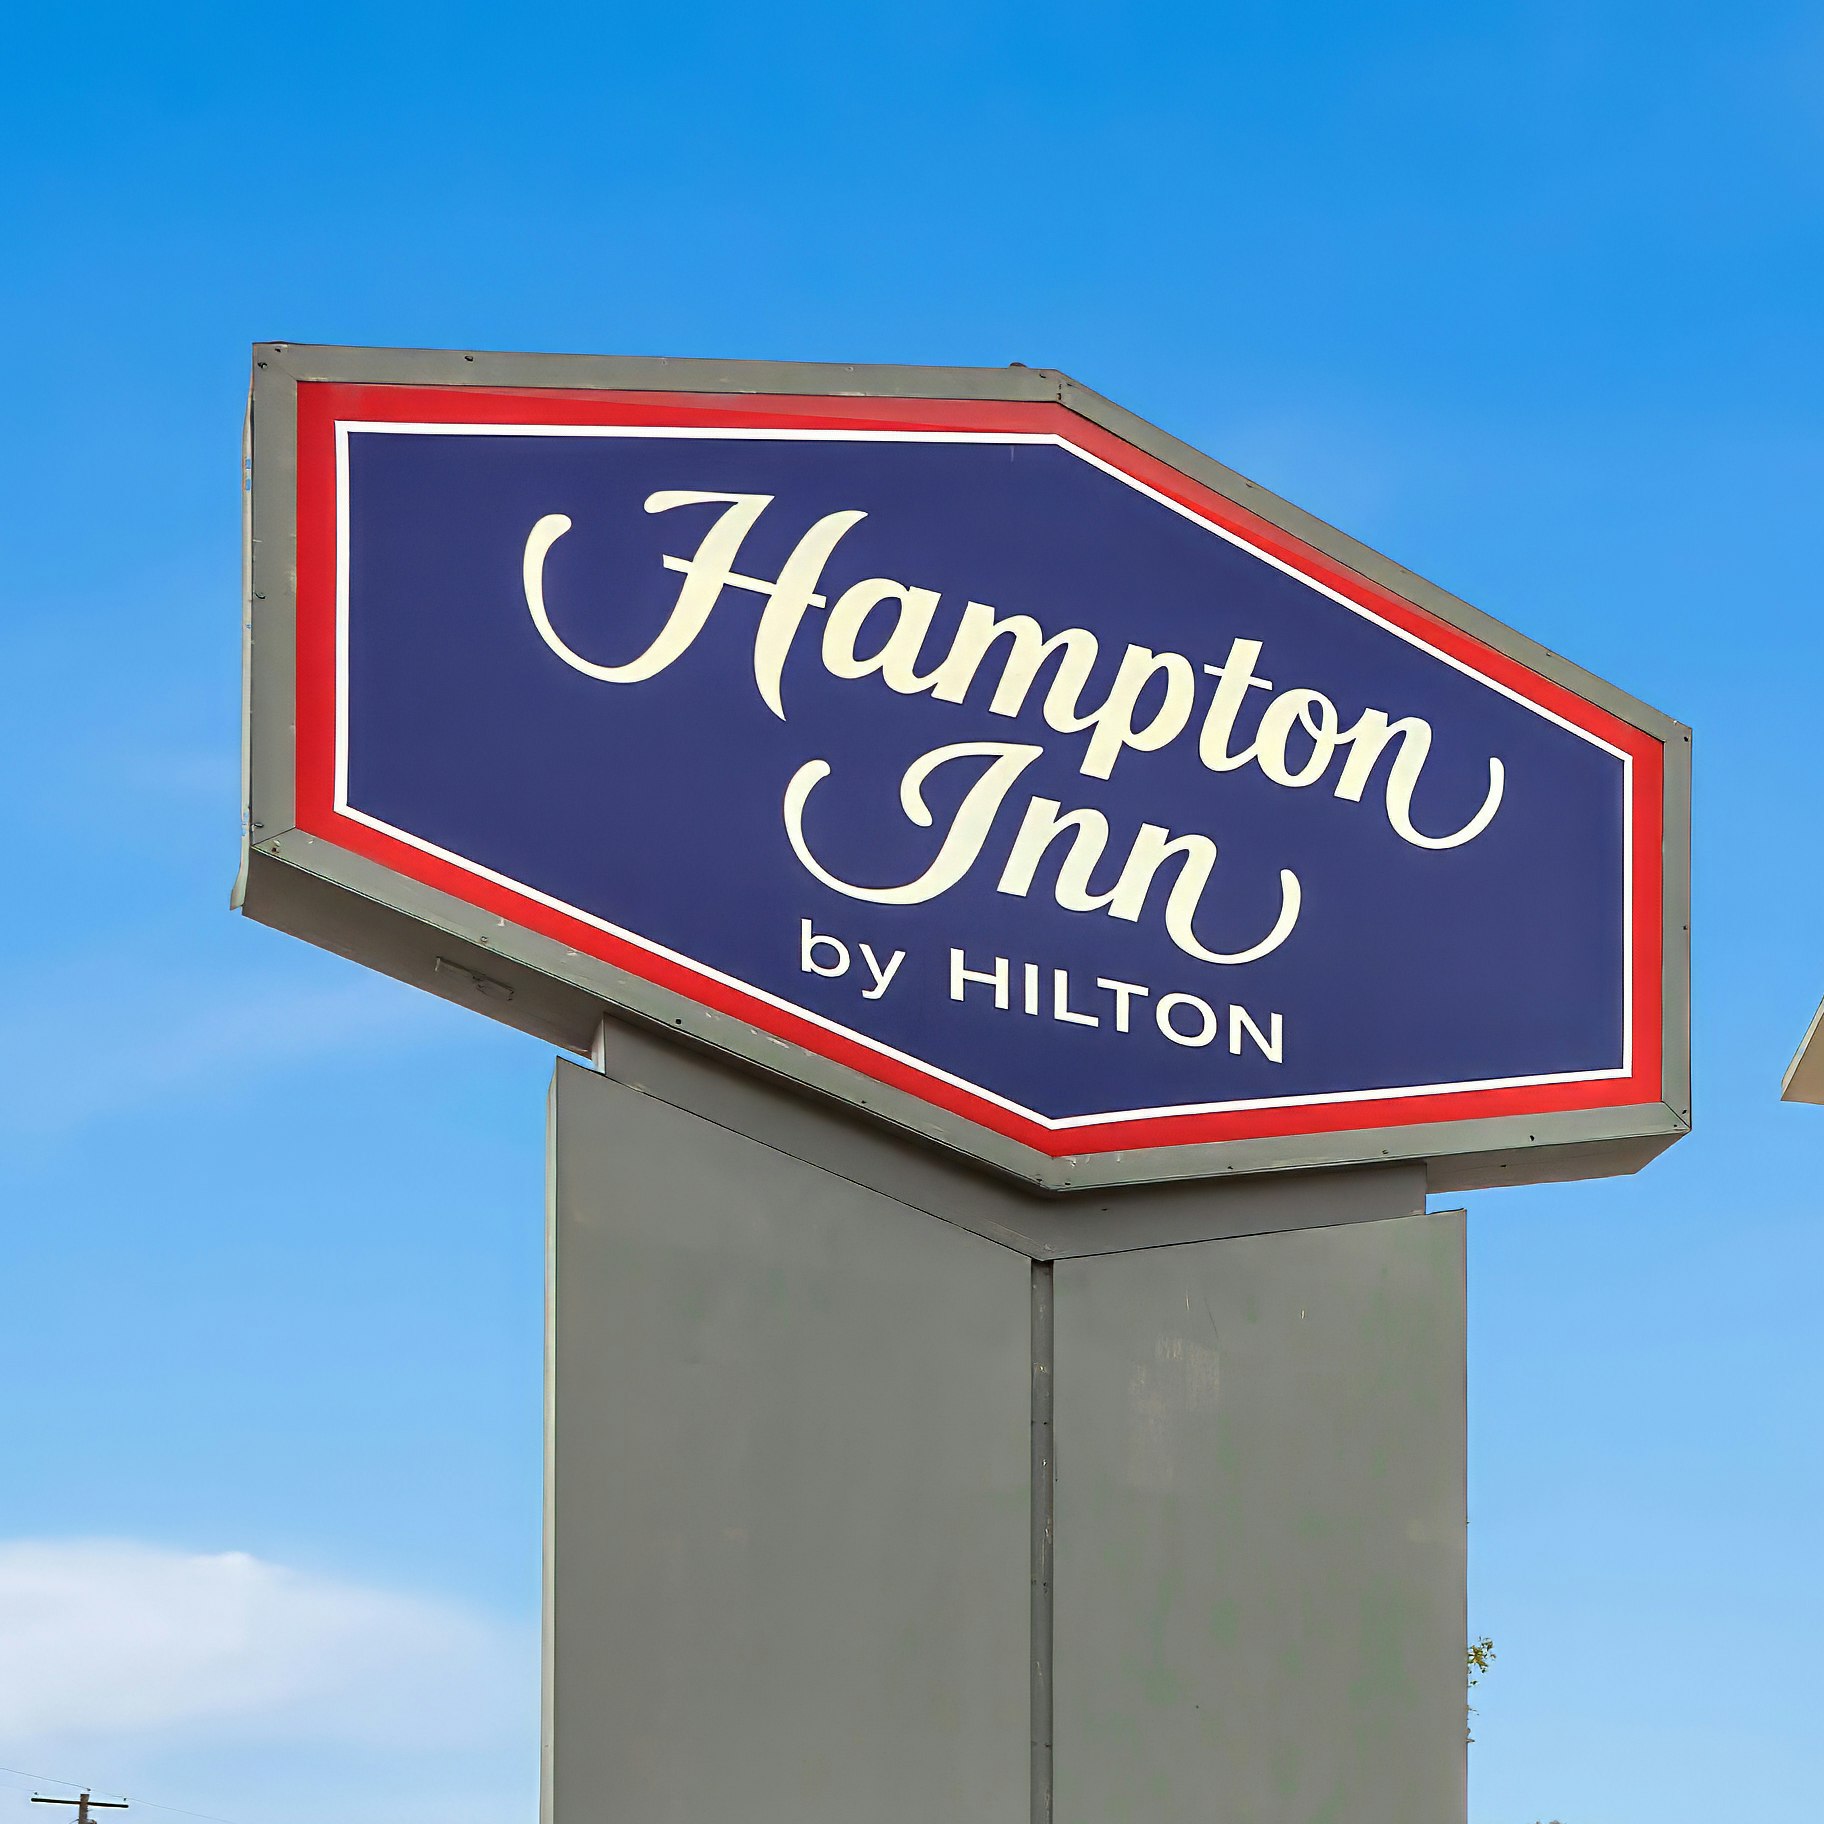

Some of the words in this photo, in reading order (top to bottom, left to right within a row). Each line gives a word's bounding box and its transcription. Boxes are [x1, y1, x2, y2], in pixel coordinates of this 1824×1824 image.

[522, 489, 1505, 851] Hampton
[783, 741, 1302, 966] Inn
[801, 918, 906, 1000] by
[950, 947, 1284, 1064] HILTON
